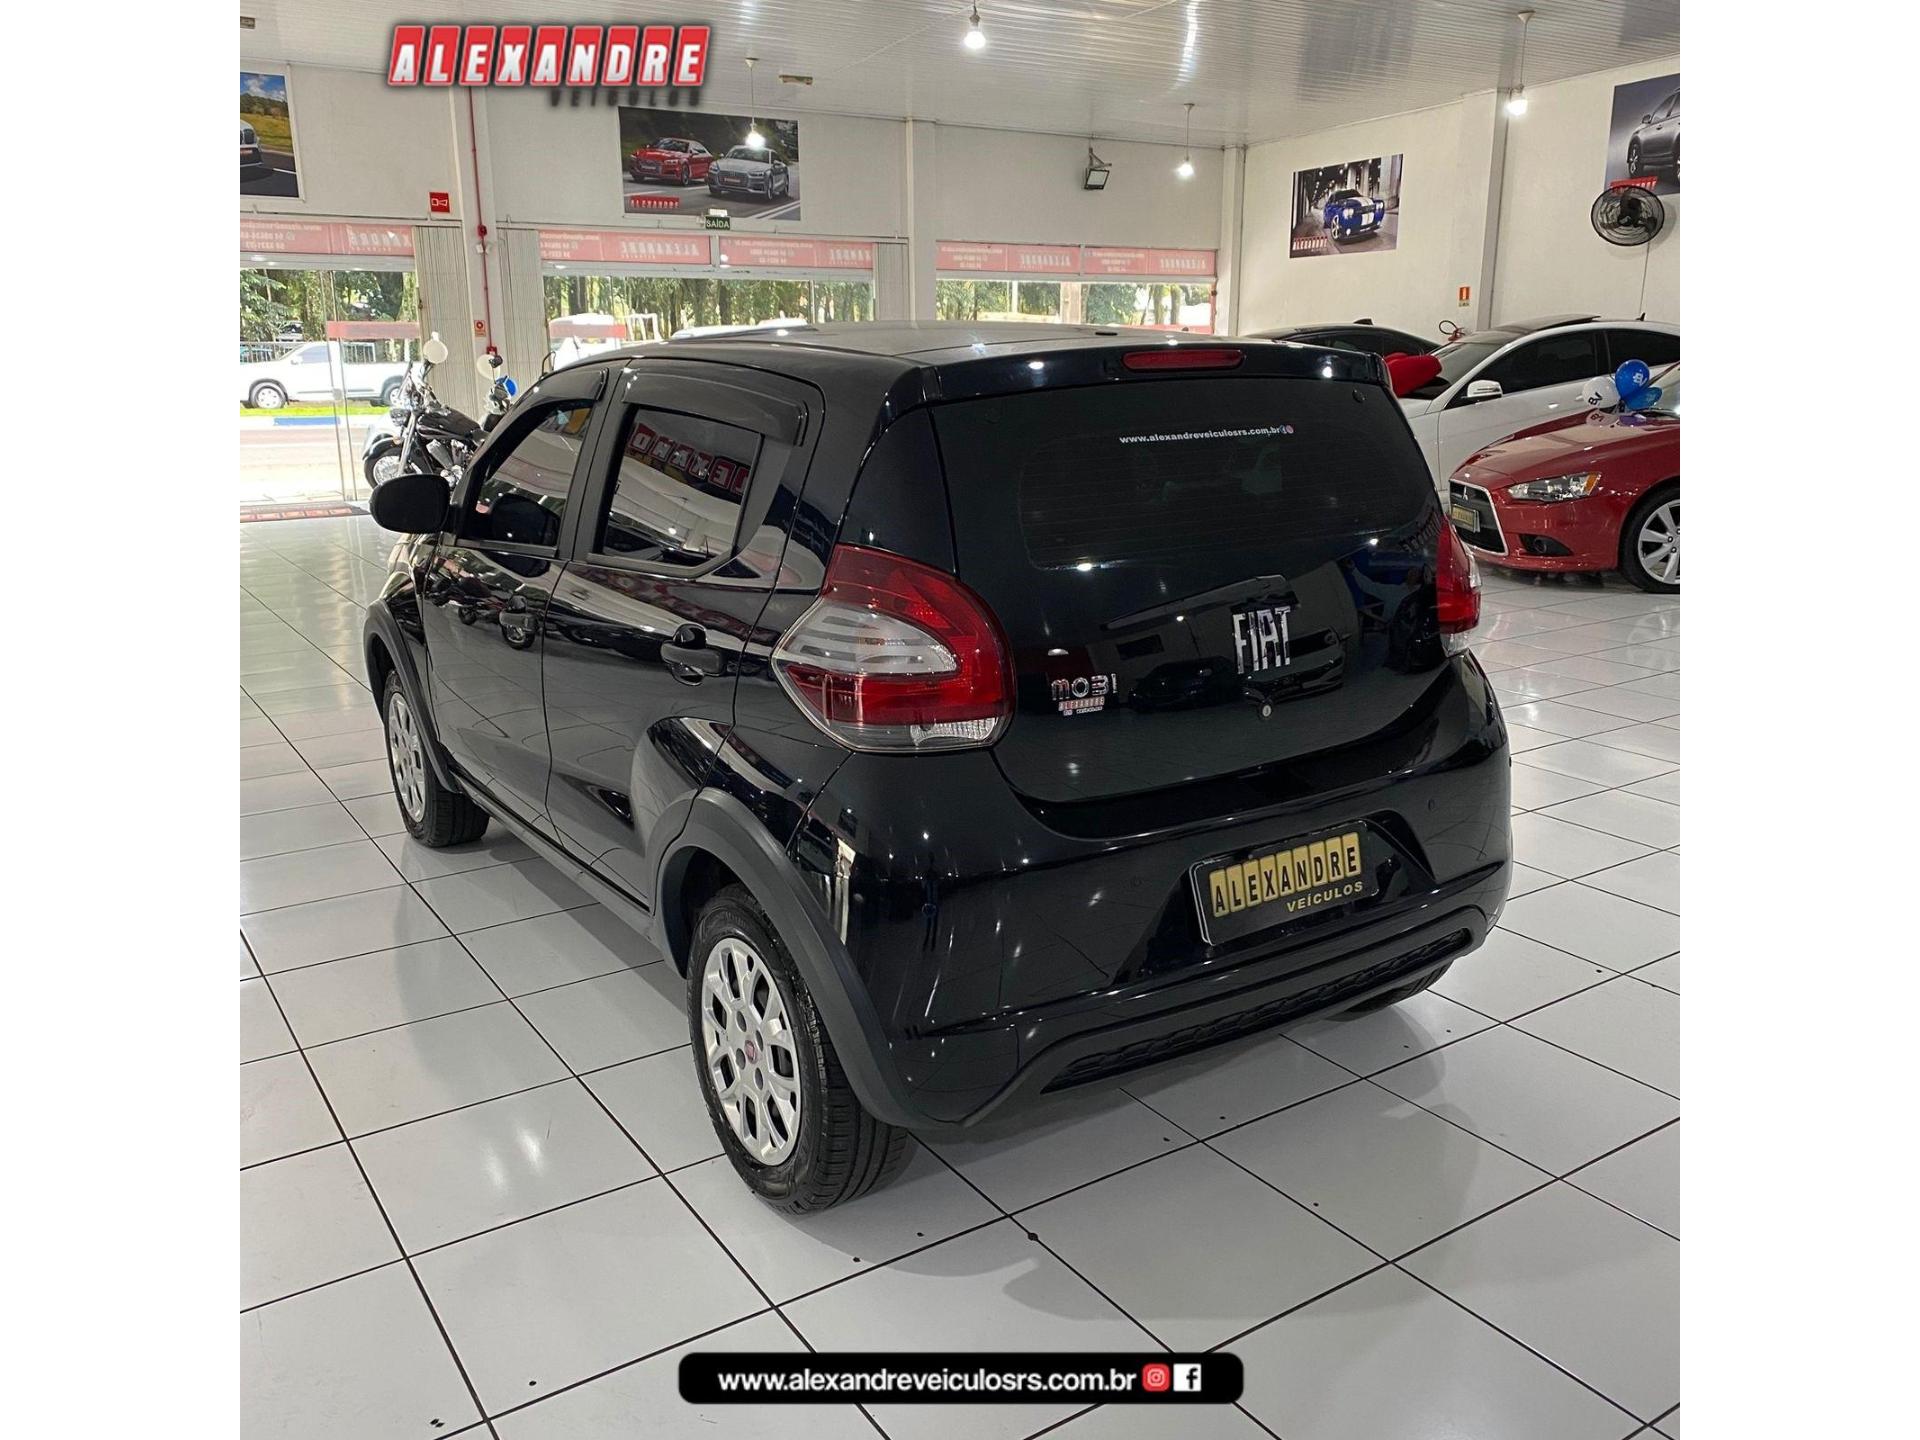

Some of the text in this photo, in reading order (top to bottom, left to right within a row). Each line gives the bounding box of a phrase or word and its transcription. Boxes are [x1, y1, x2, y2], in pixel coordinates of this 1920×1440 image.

[706, 218, 730, 229] SAÍDA
[1119, 425, 1280, 444] www.alexandreveiculosrs.com.br
[1231, 605, 1291, 675] FIAT
[1051, 673, 1118, 701] MOBI
[1215, 846, 1358, 914] ALEXANDRE
[1286, 881, 1363, 913] VEÍCULOS
